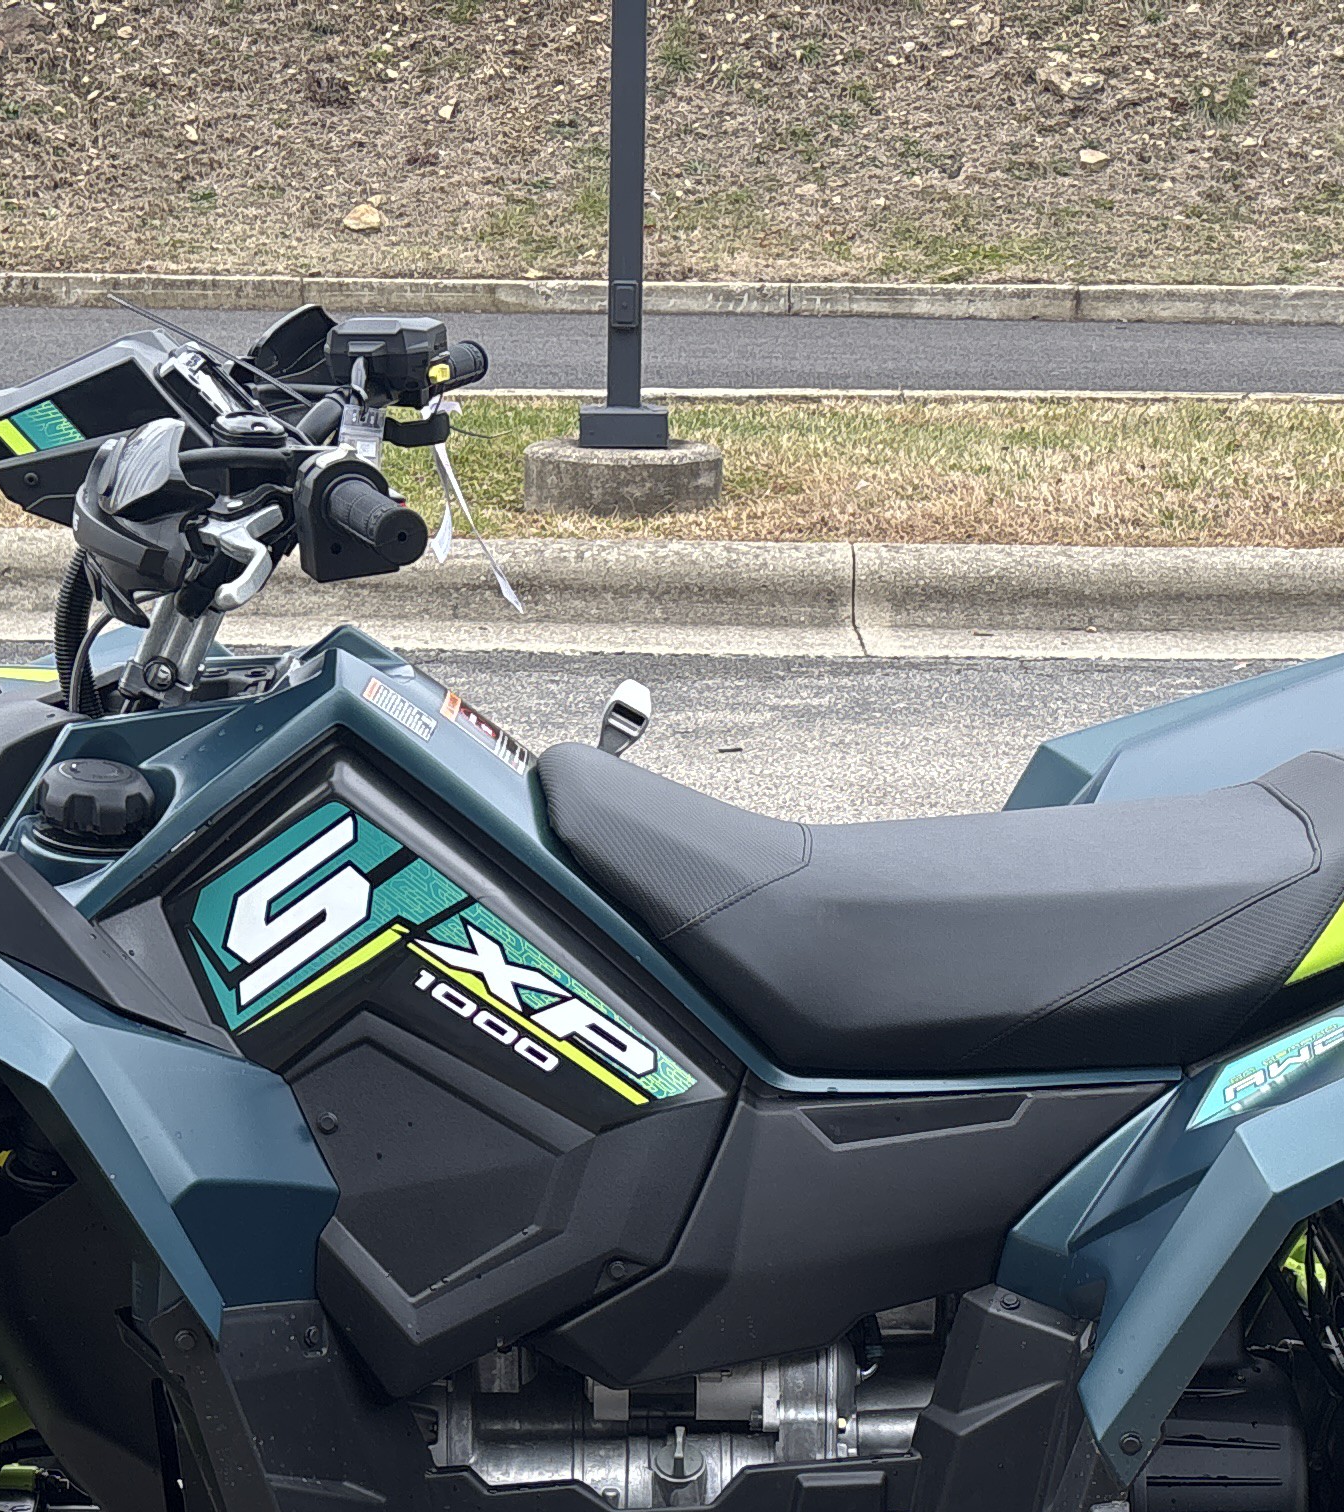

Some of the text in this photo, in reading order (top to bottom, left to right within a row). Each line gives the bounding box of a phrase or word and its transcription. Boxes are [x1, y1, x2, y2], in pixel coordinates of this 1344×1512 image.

[225, 814, 372, 1007] S
[414, 969, 560, 1073] 1000
[415, 922, 658, 1077] XP
